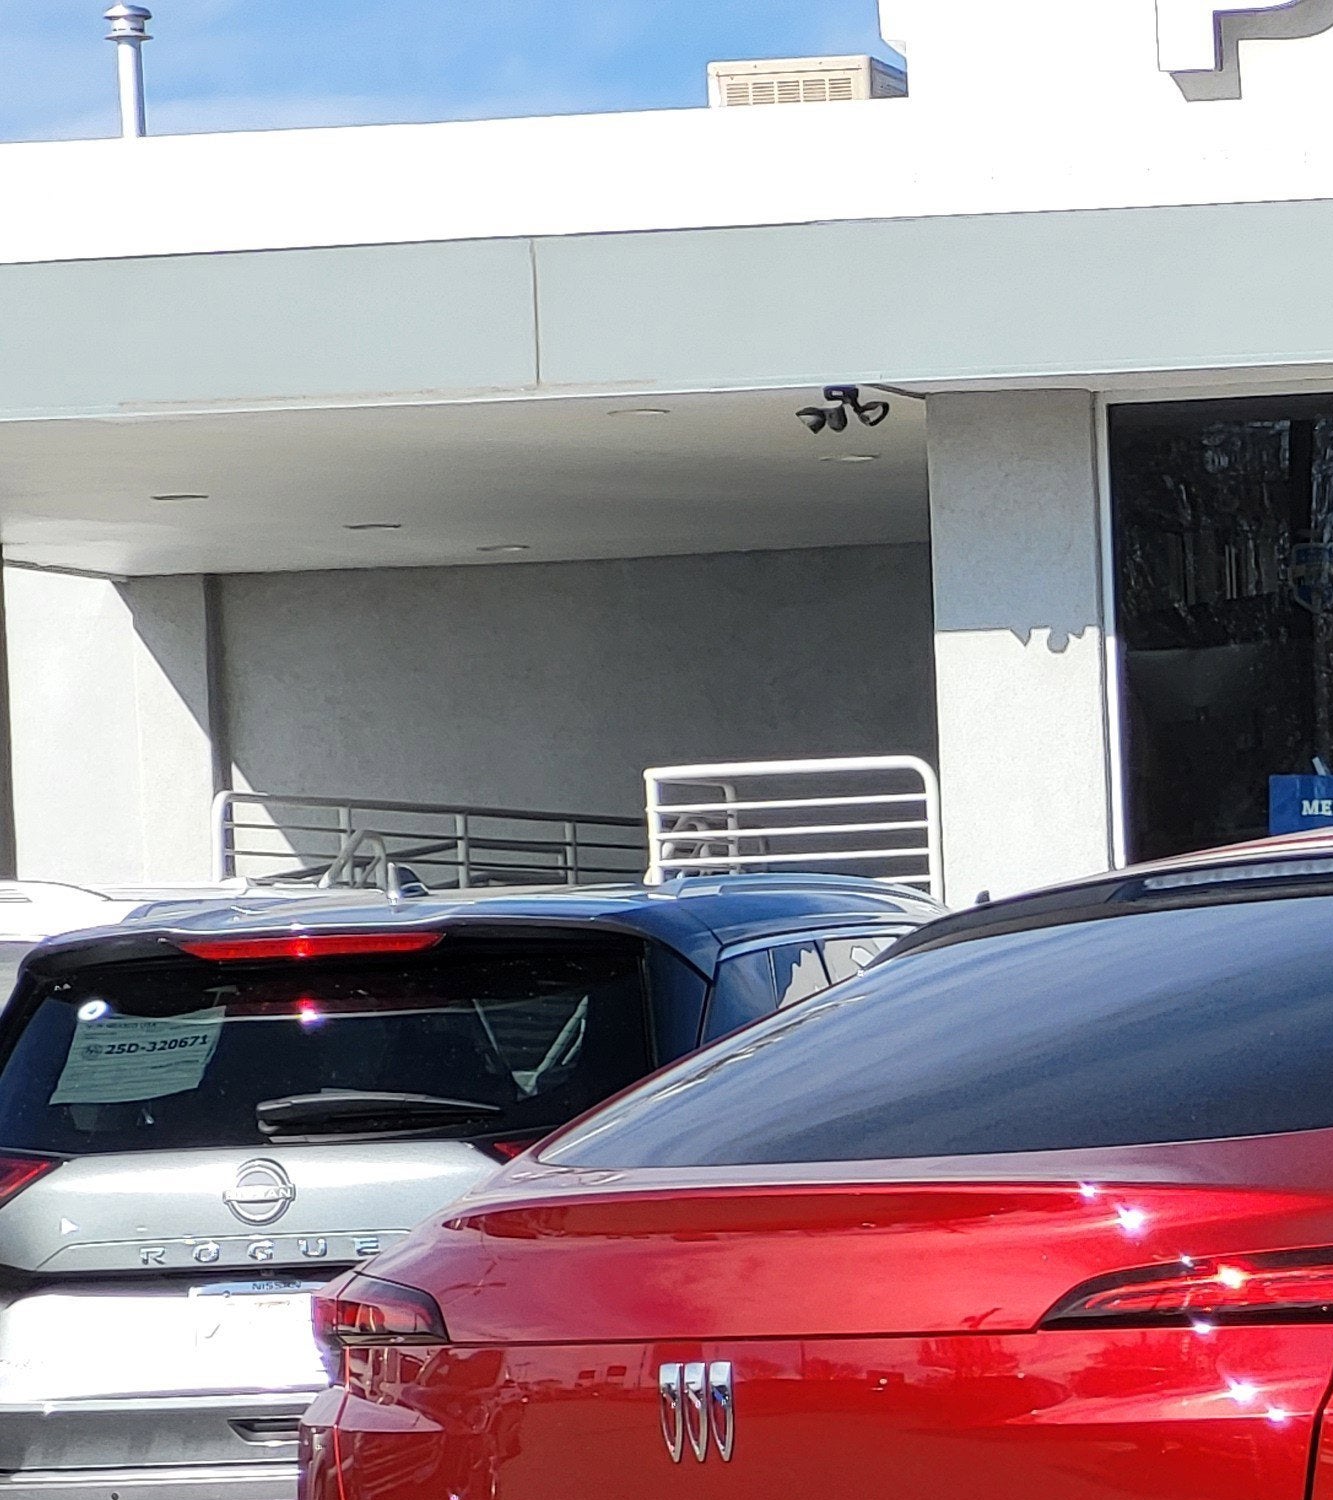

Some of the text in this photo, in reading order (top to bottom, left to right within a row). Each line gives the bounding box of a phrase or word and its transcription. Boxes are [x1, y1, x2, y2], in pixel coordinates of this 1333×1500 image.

[104, 1034, 208, 1055] 25D-320671
[140, 1237, 381, 1266] ROGUE
[252, 1281, 302, 1291] NISSAN
